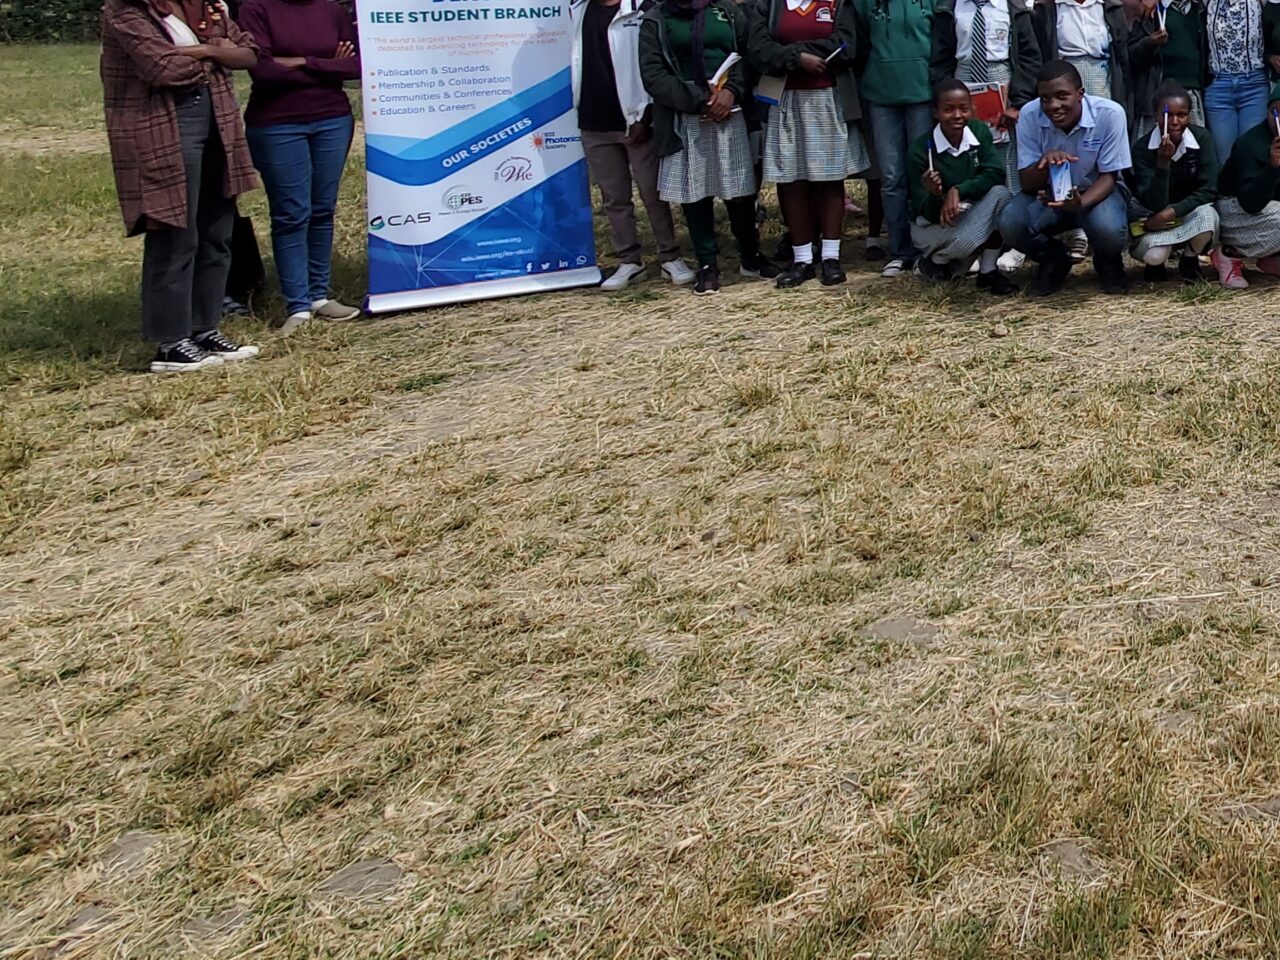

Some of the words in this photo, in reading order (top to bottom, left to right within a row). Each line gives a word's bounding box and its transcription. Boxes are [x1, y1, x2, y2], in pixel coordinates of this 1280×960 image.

[370, 11, 404, 23] IEEE
[408, 8, 491, 23] STUDENT
[494, 6, 562, 20] BRANCH
[377, 68, 428, 77] Publication
[431, 66, 438, 74] &
[441, 65, 490, 74] Standards
[378, 80, 436, 90] Membership
[438, 79, 445, 87] &
[448, 76, 511, 86] Collaboration
[379, 93, 441, 102] Communities
[443, 91, 450, 99] &
[454, 88, 512, 99] Conferences
[379, 106, 425, 115] Education
[428, 105, 436, 113] &
[439, 103, 476, 112] Careers
[442, 150, 470, 168] OUR
[470, 117, 533, 154] SOCIETIES
[460, 196, 483, 206] PES
[387, 212, 431, 226] CAS
